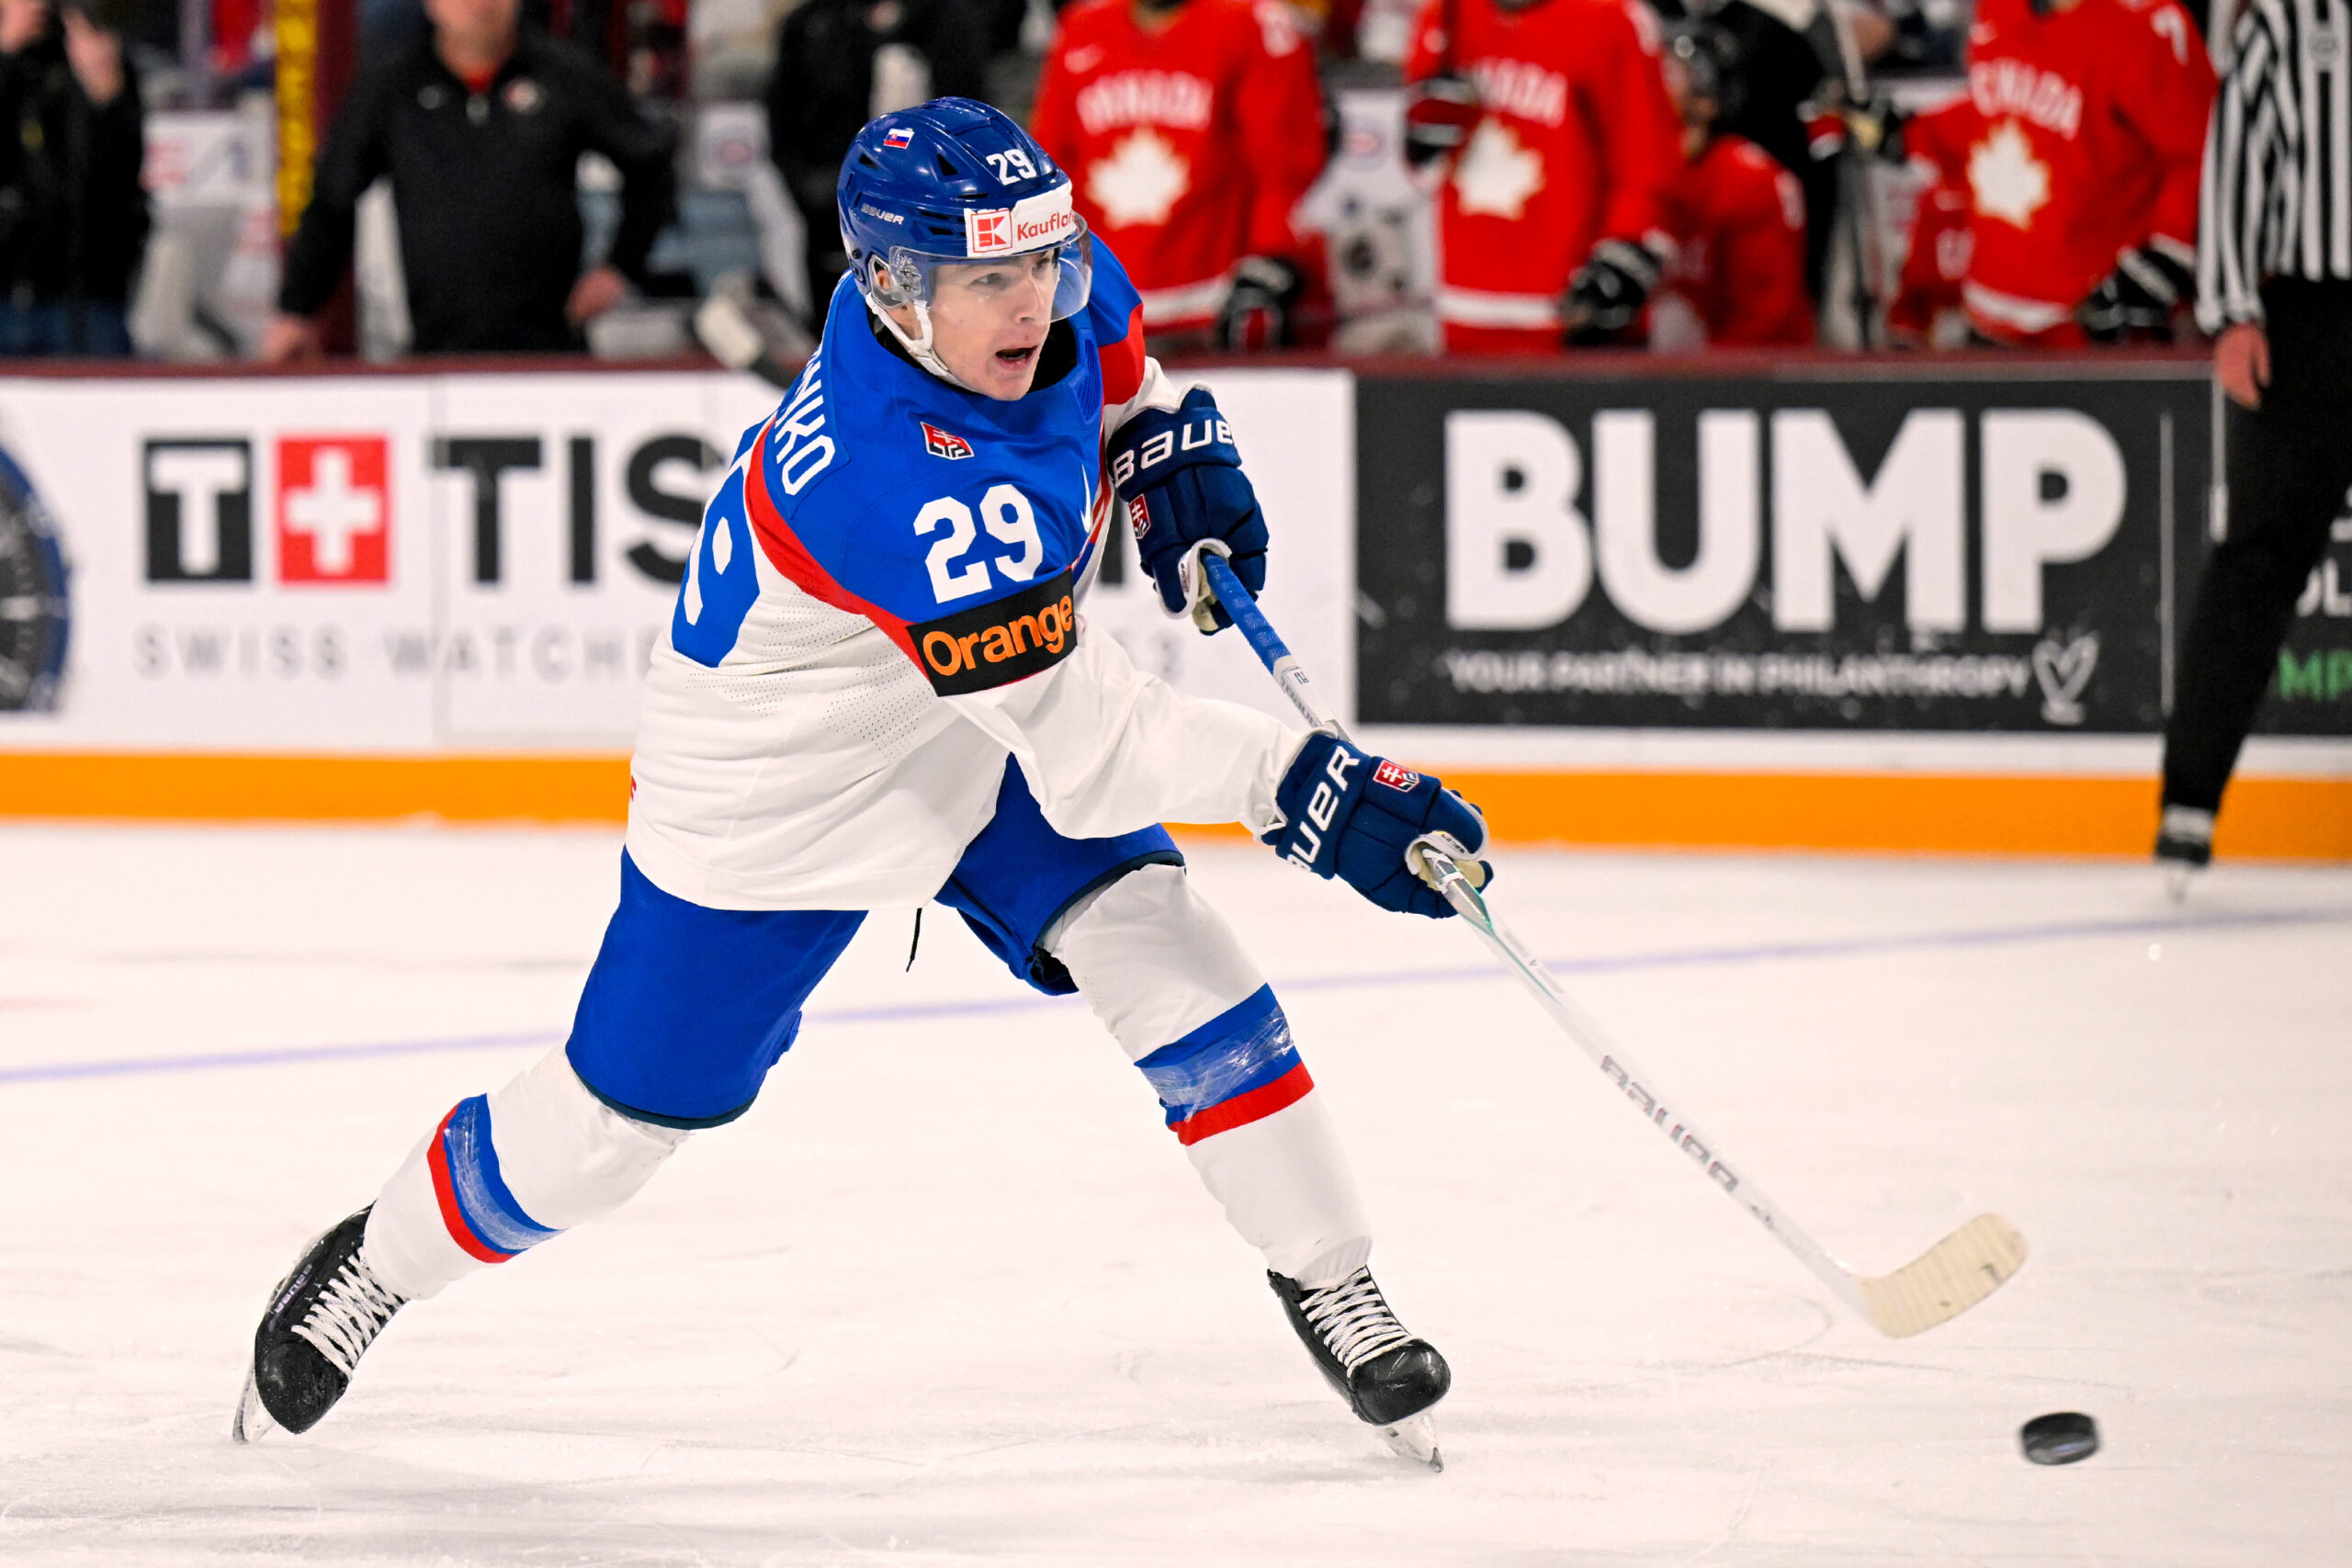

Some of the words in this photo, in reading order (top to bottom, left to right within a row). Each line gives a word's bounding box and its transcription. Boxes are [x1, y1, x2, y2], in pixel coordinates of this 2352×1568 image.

[986, 149, 1037, 186] 29
[860, 203, 905, 225] BAUER
[1113, 419, 1234, 489] BAUE
[913, 483, 1043, 604] 29
[1443, 408, 2127, 636] BUMP
[131, 622, 348, 683] SWISS
[922, 595, 1073, 676] Orange
